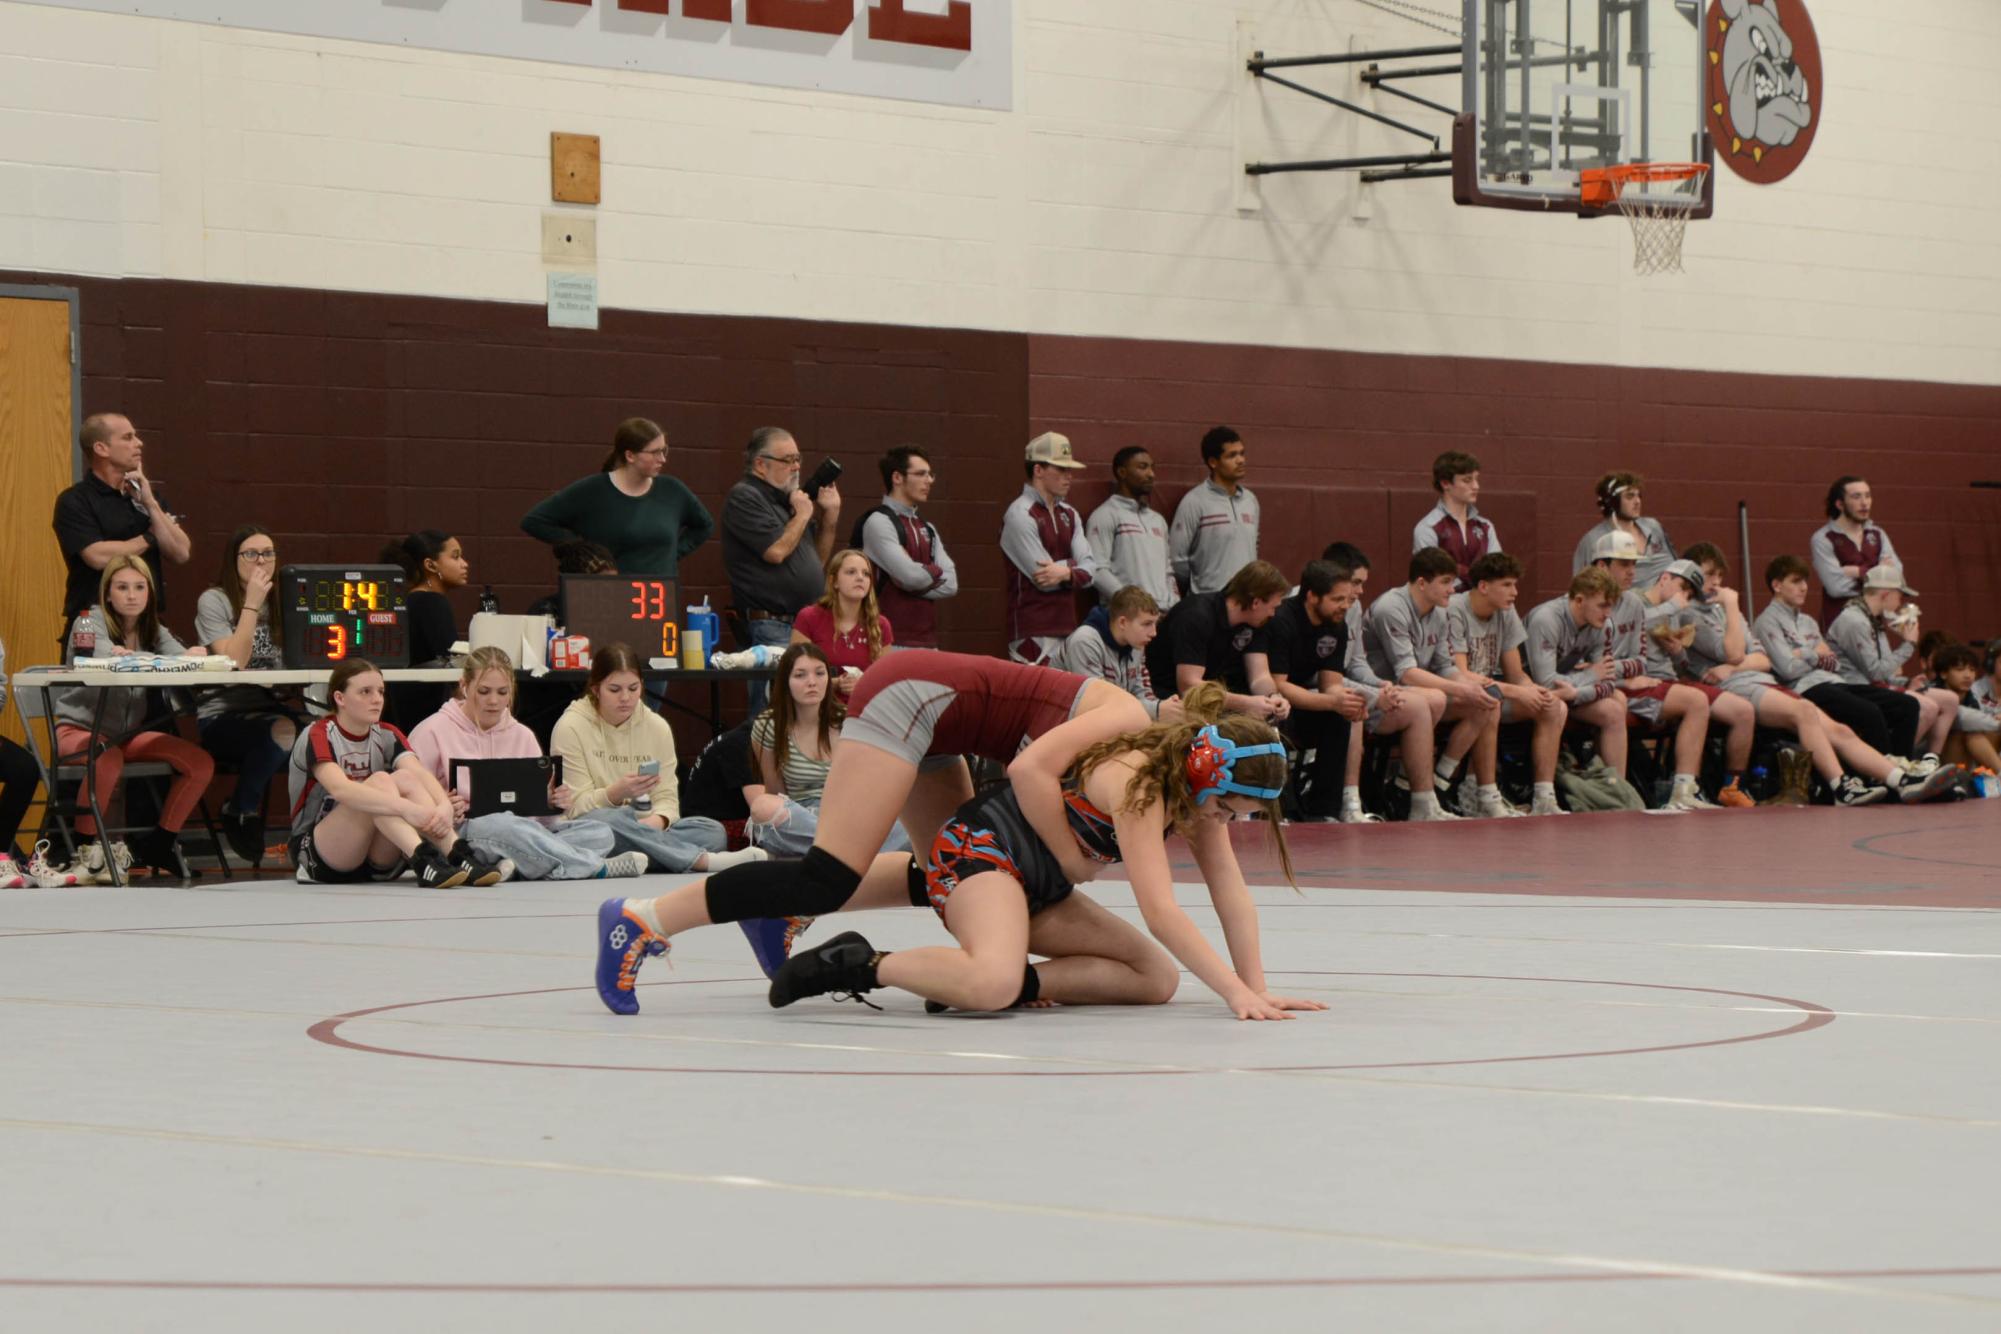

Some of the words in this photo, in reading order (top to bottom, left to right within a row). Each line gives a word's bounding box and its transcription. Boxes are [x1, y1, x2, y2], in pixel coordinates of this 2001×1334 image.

[631, 581, 665, 620] 33
[310, 614, 335, 624] HOME
[369, 613, 393, 624] GUEST
[328, 625, 346, 660] 3
[662, 621, 677, 657] 0
